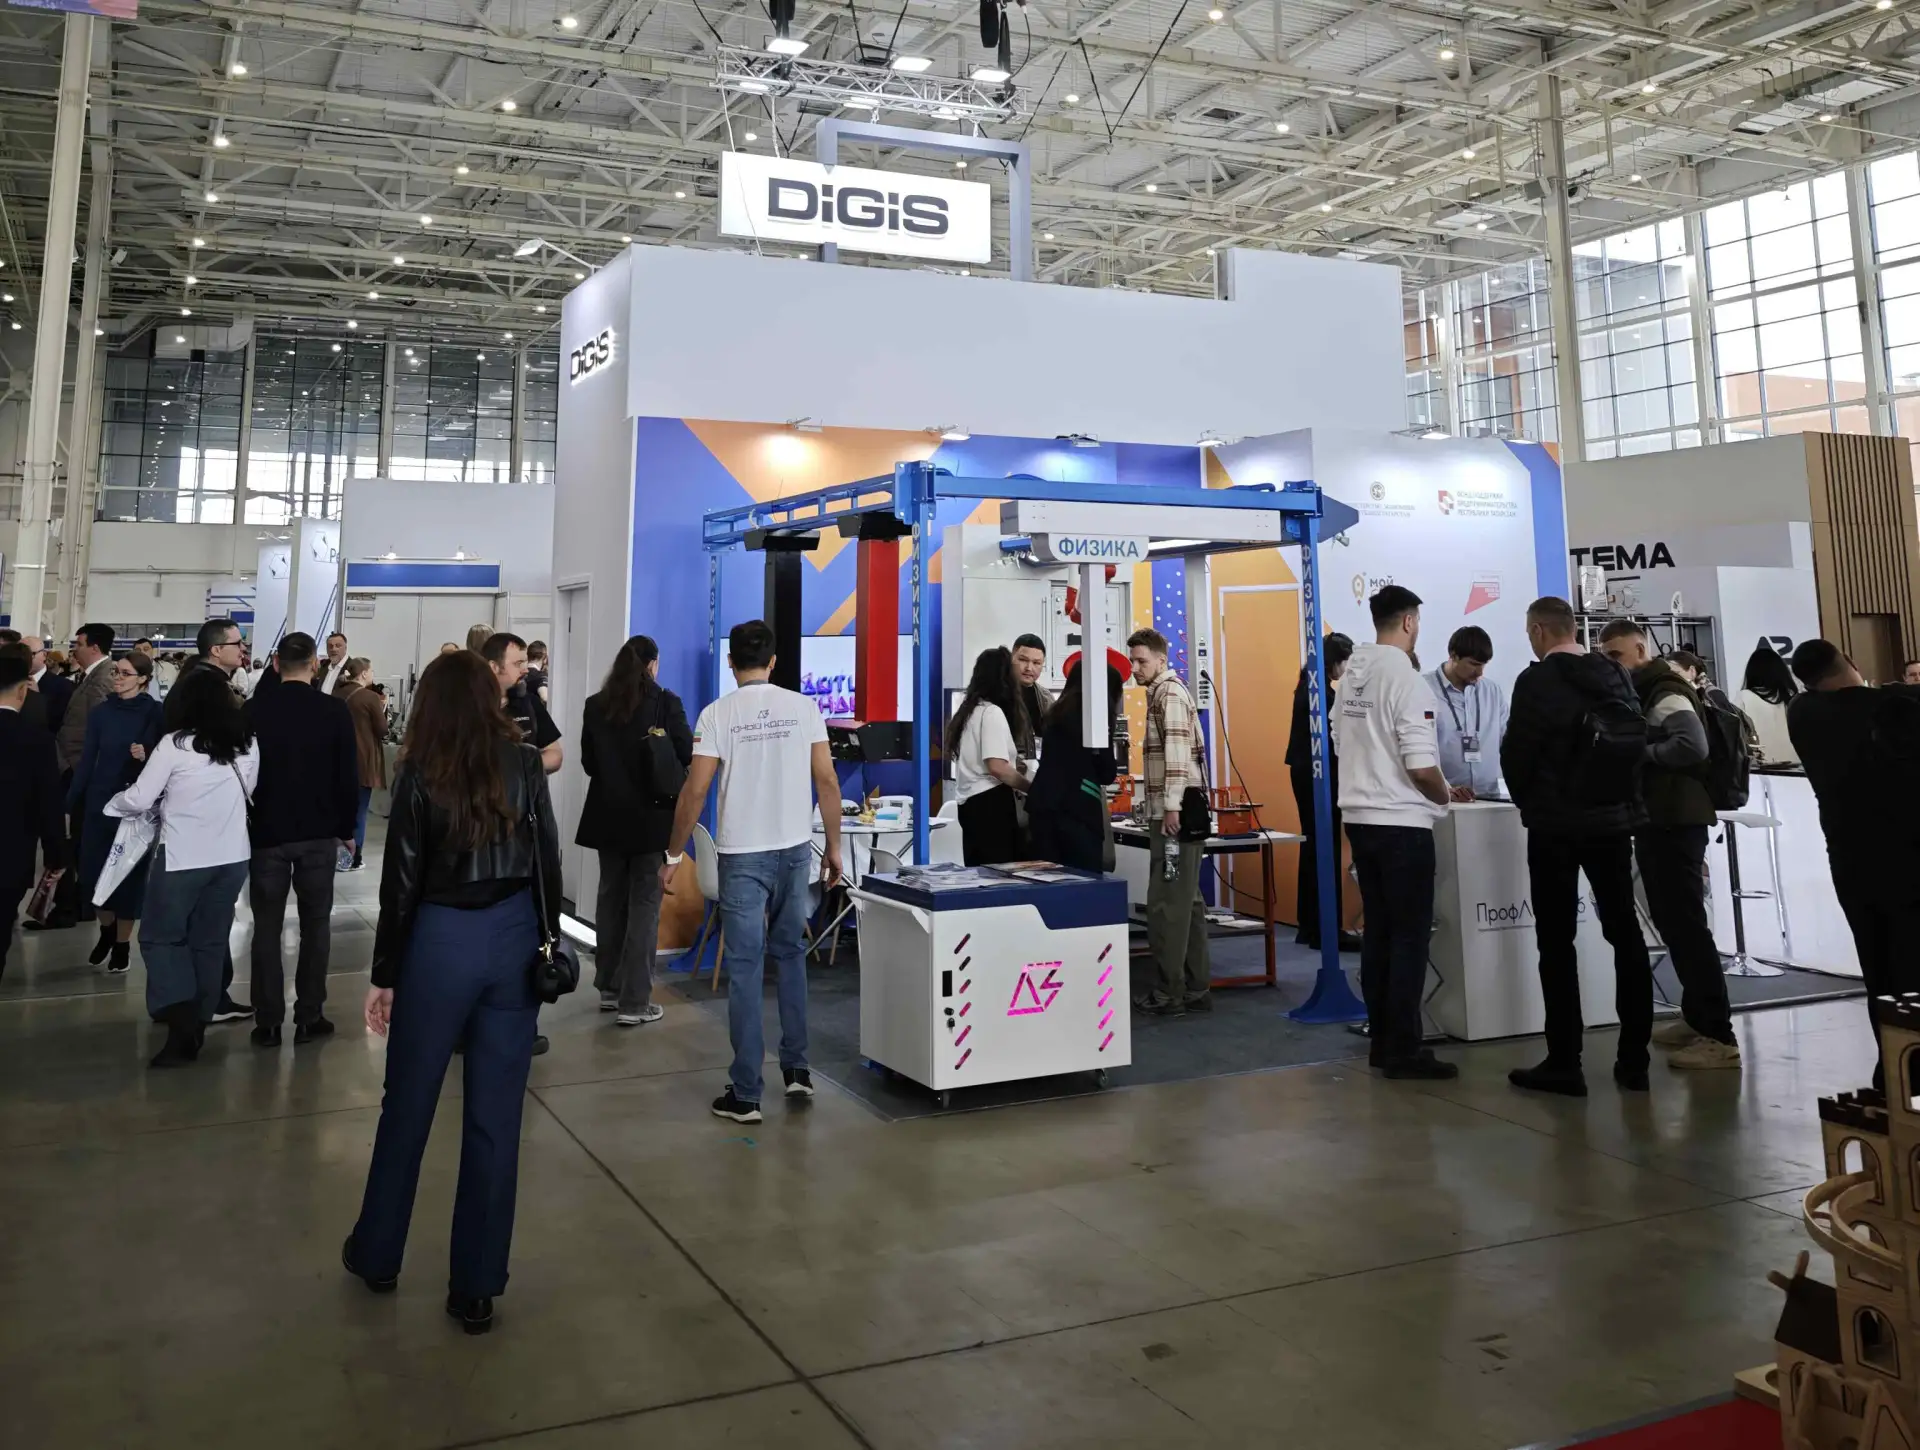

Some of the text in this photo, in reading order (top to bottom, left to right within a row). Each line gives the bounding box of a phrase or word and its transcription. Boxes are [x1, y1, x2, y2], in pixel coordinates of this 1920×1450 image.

[768, 177, 949, 235] DiGiS
[911, 520, 920, 646] ФИЗИКА
[1058, 537, 1139, 558] ФИЗИКА
[1301, 544, 1323, 780] ФИЗИКА ХИМИЯ
